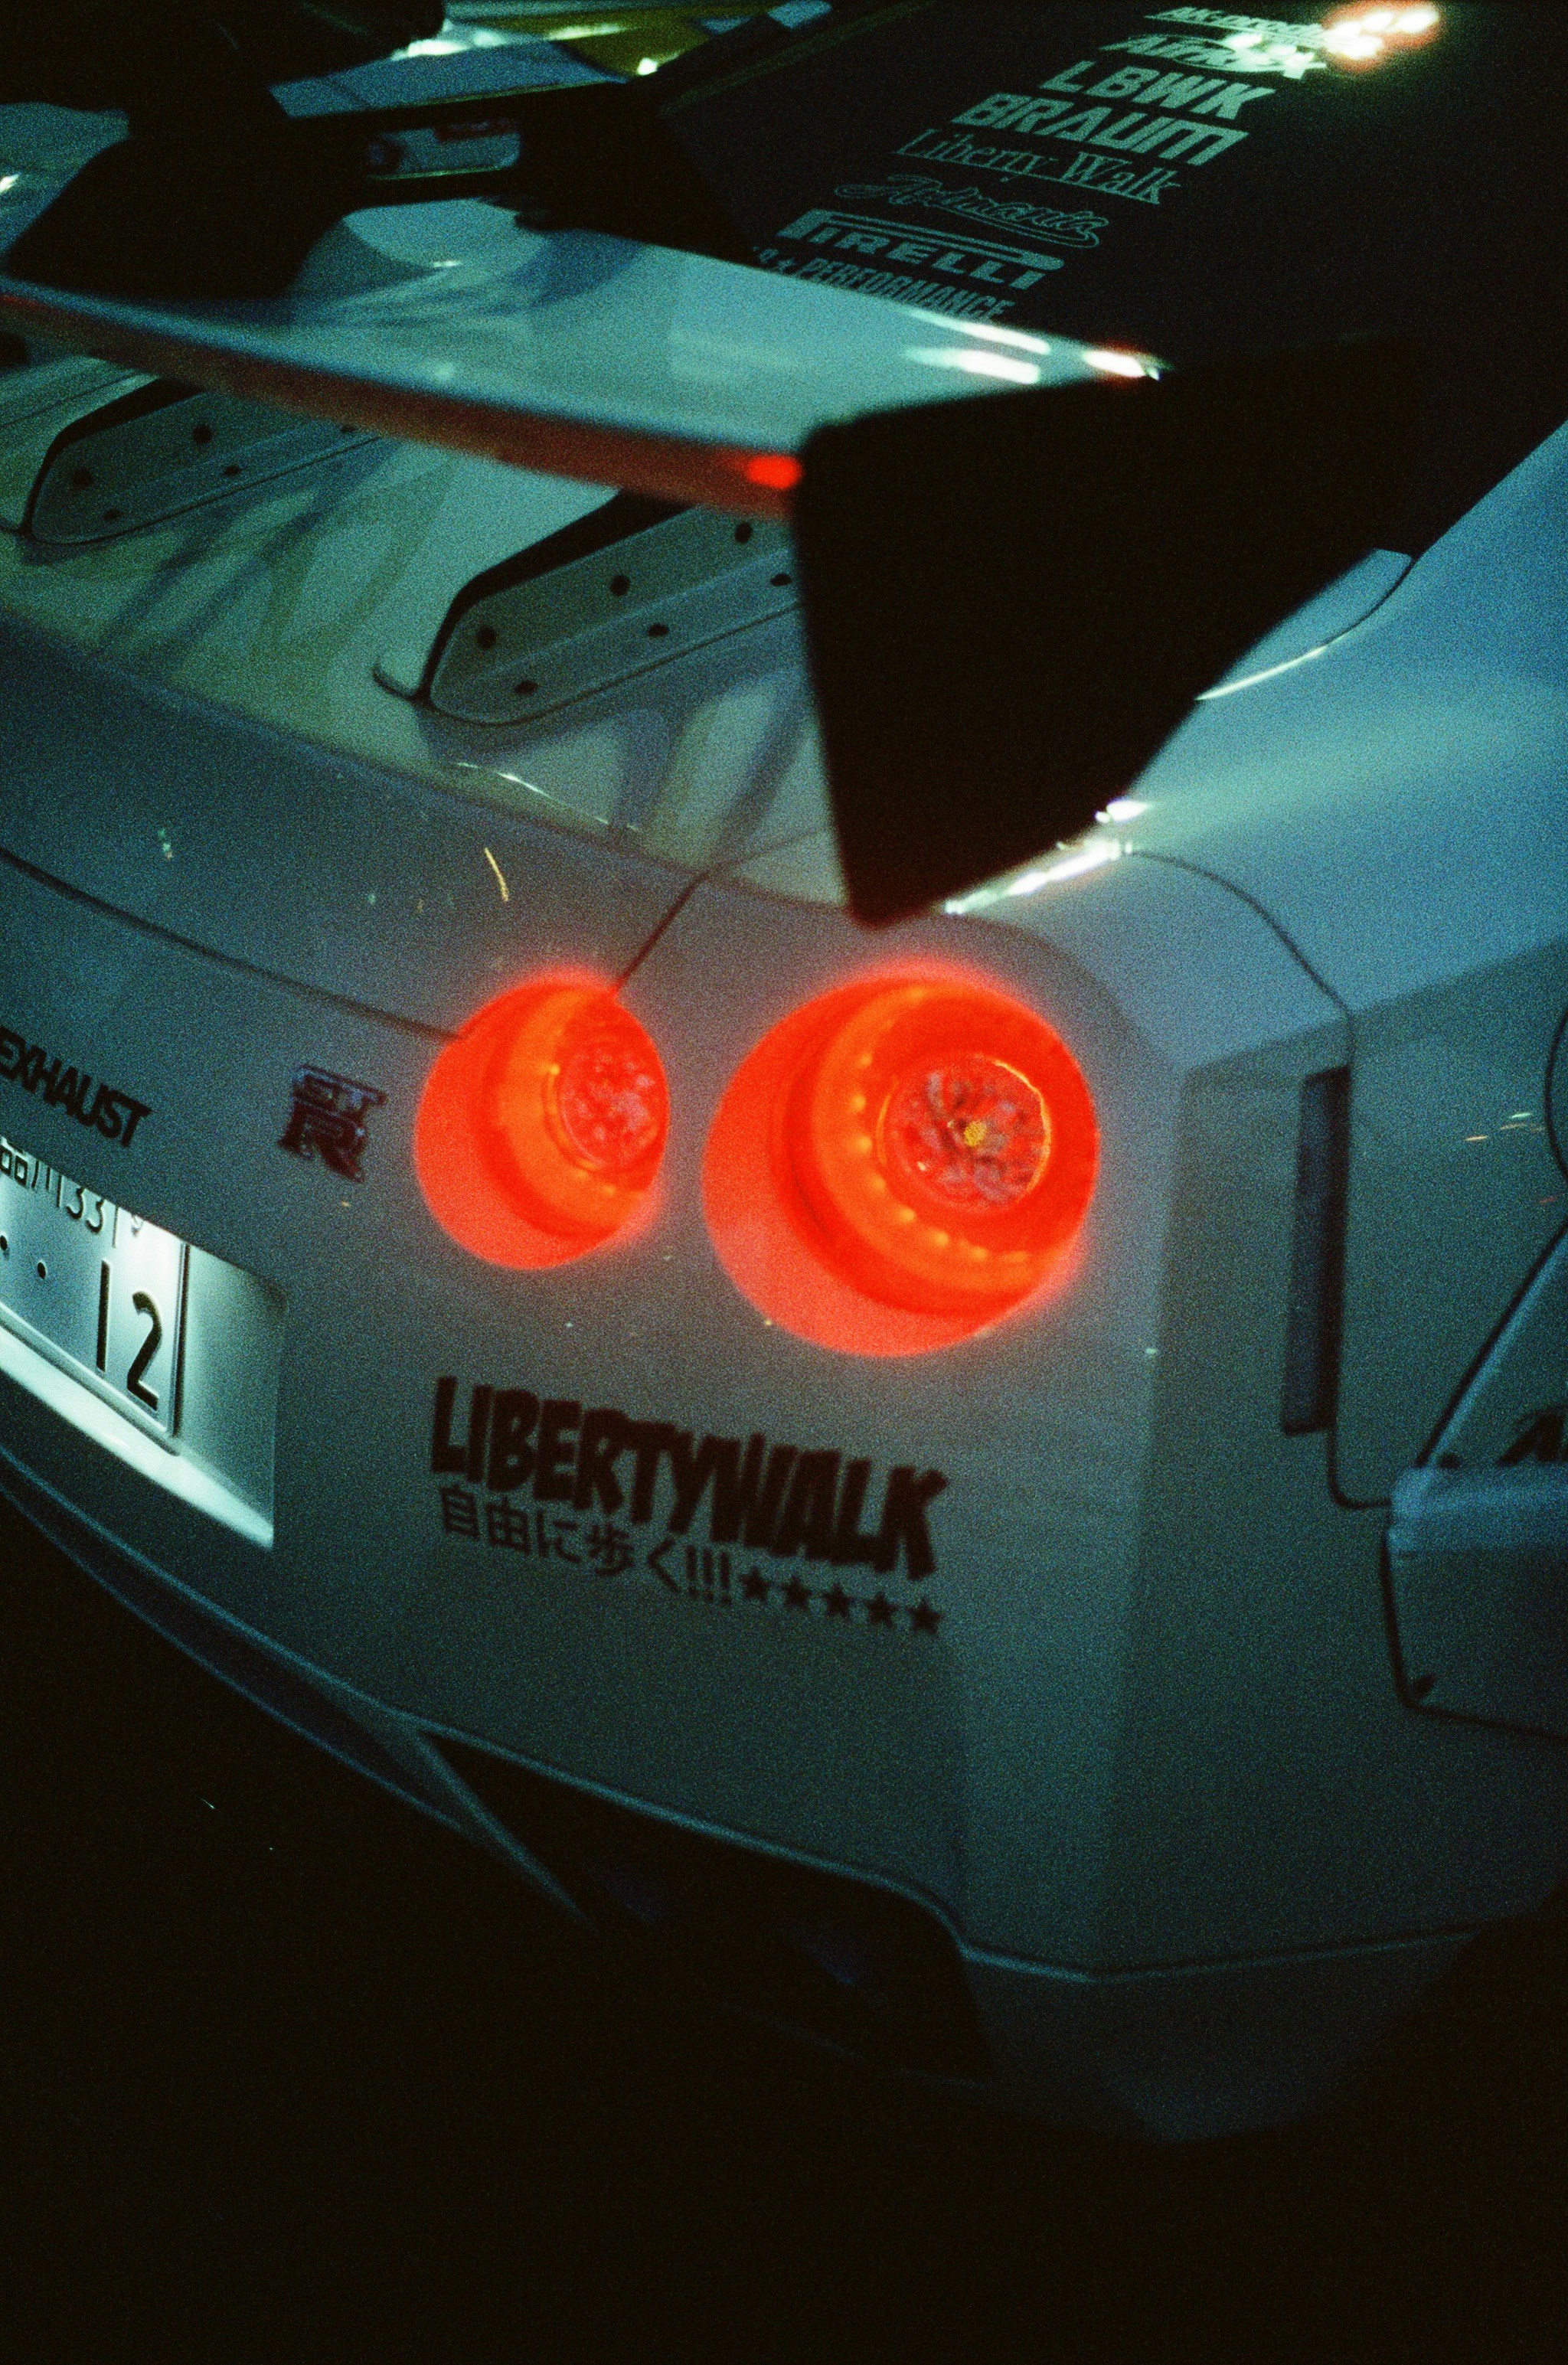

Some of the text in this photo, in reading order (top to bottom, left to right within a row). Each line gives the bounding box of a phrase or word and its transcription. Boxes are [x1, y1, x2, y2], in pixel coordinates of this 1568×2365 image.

[1037, 60, 1277, 119] LBWK
[891, 127, 1181, 204] Liberty Walk
[949, 91, 1250, 166] BRAUM
[776, 208, 1065, 290] PIRELLI
[0, 1026, 152, 1148] EXHAUST
